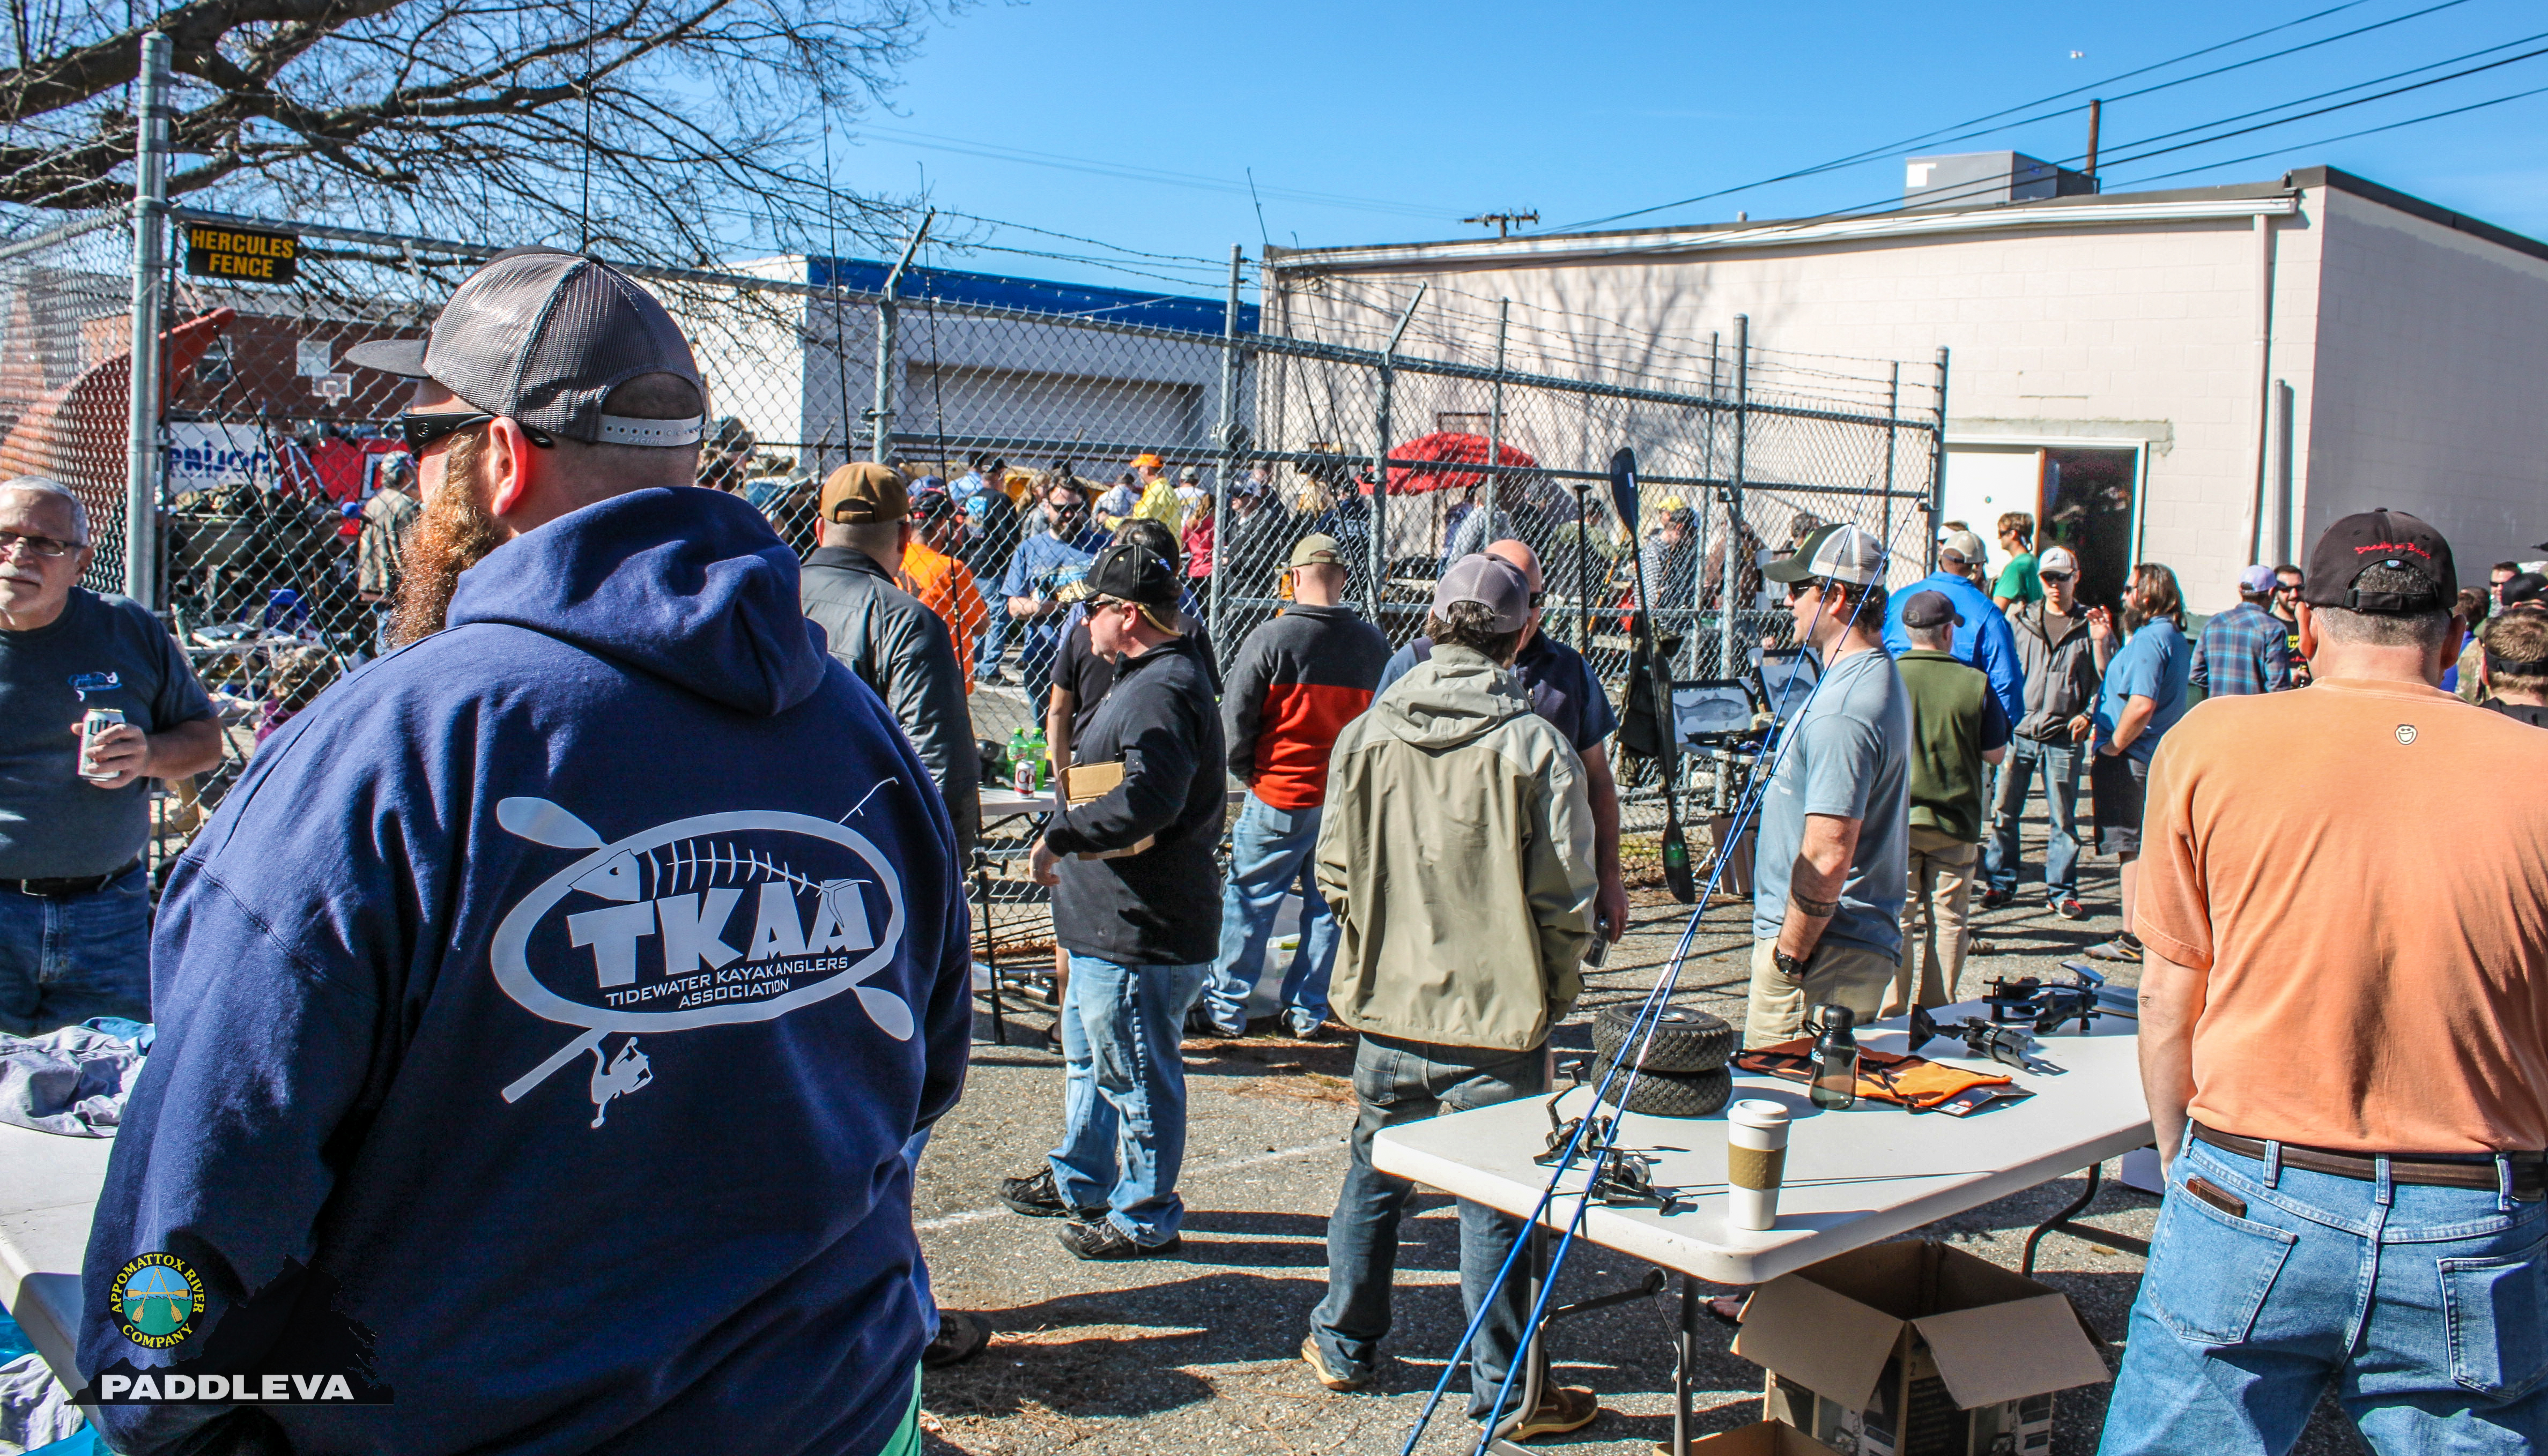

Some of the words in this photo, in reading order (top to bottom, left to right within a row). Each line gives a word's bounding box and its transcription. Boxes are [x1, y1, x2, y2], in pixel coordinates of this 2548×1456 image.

[190, 228, 294, 259] HERCULES
[208, 252, 274, 278] FENCE
[627, 437, 664, 445] PACIFIC
[566, 878, 875, 989] TKAA
[604, 973, 711, 1007] TIDEWATER
[678, 977, 790, 1009] ASSOCIATION
